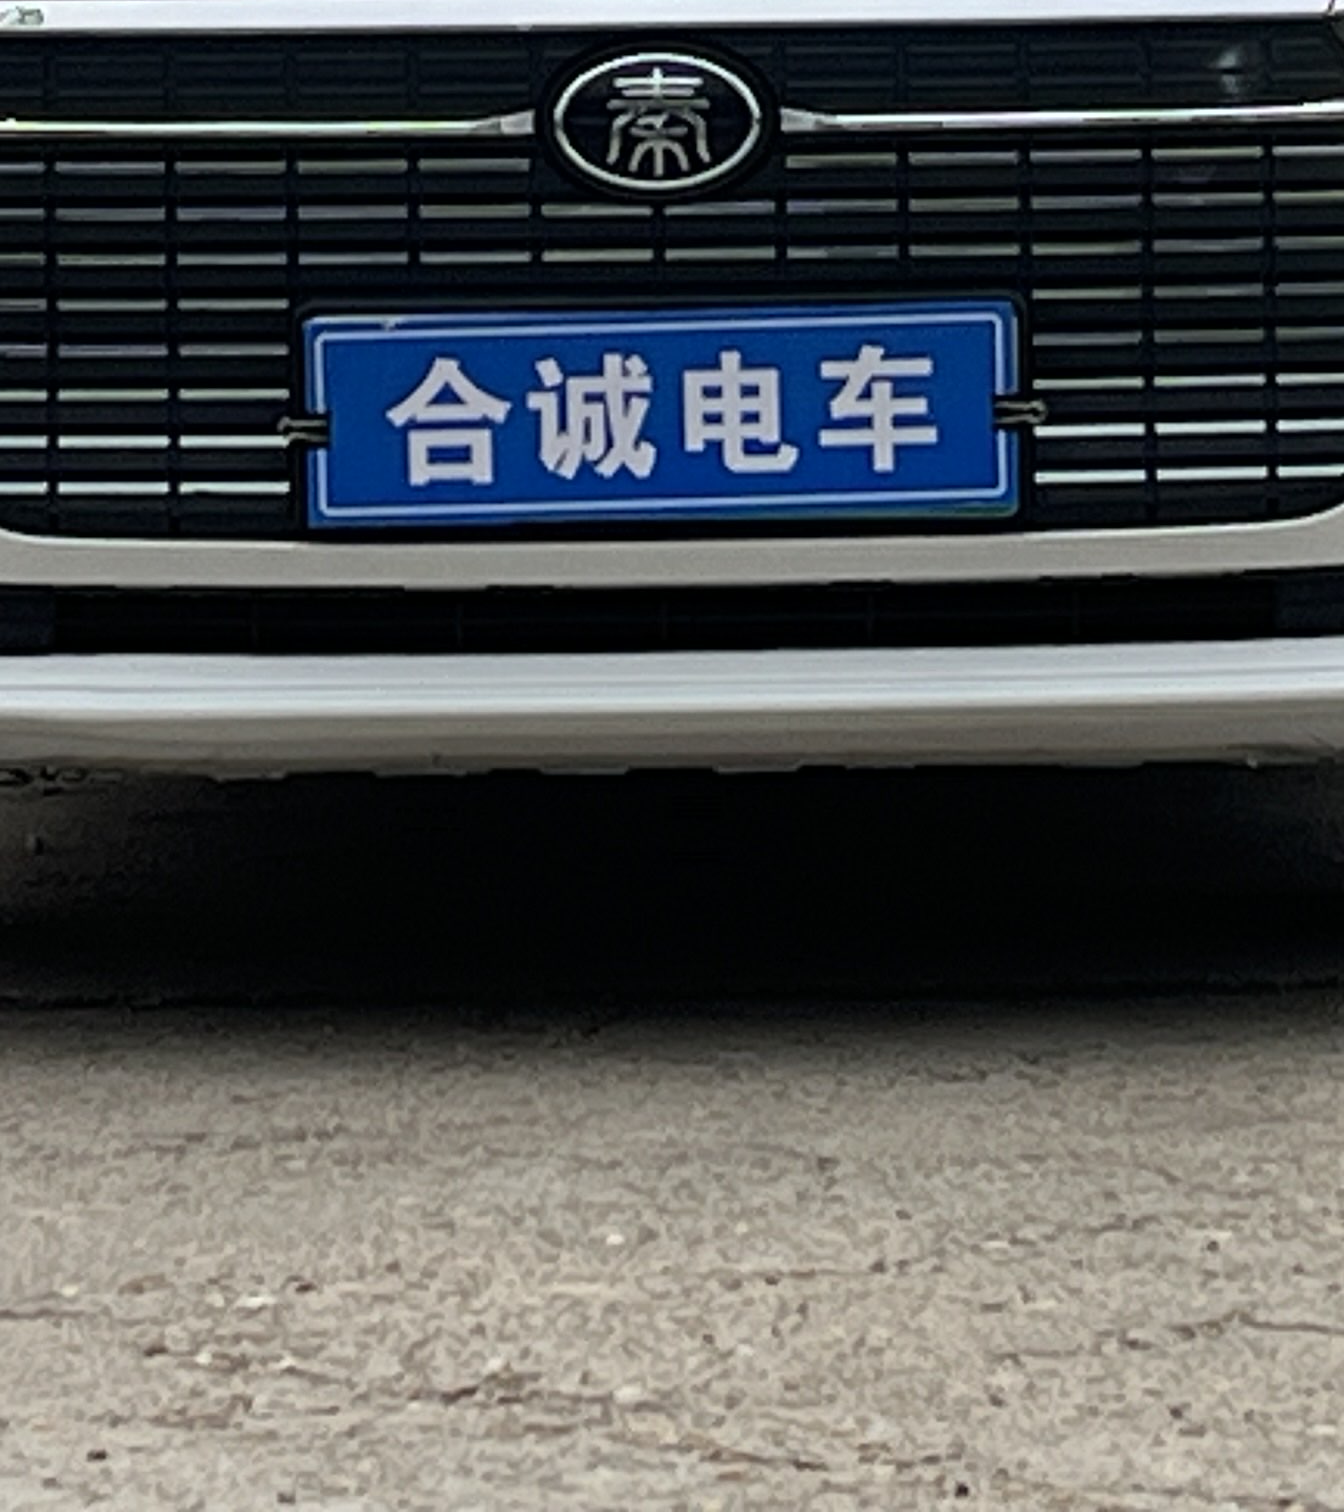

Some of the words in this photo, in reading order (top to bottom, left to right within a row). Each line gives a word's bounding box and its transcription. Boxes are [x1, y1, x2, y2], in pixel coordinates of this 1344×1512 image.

[607, 67, 710, 176] 秦
[385, 345, 938, 486] 合诚电车
